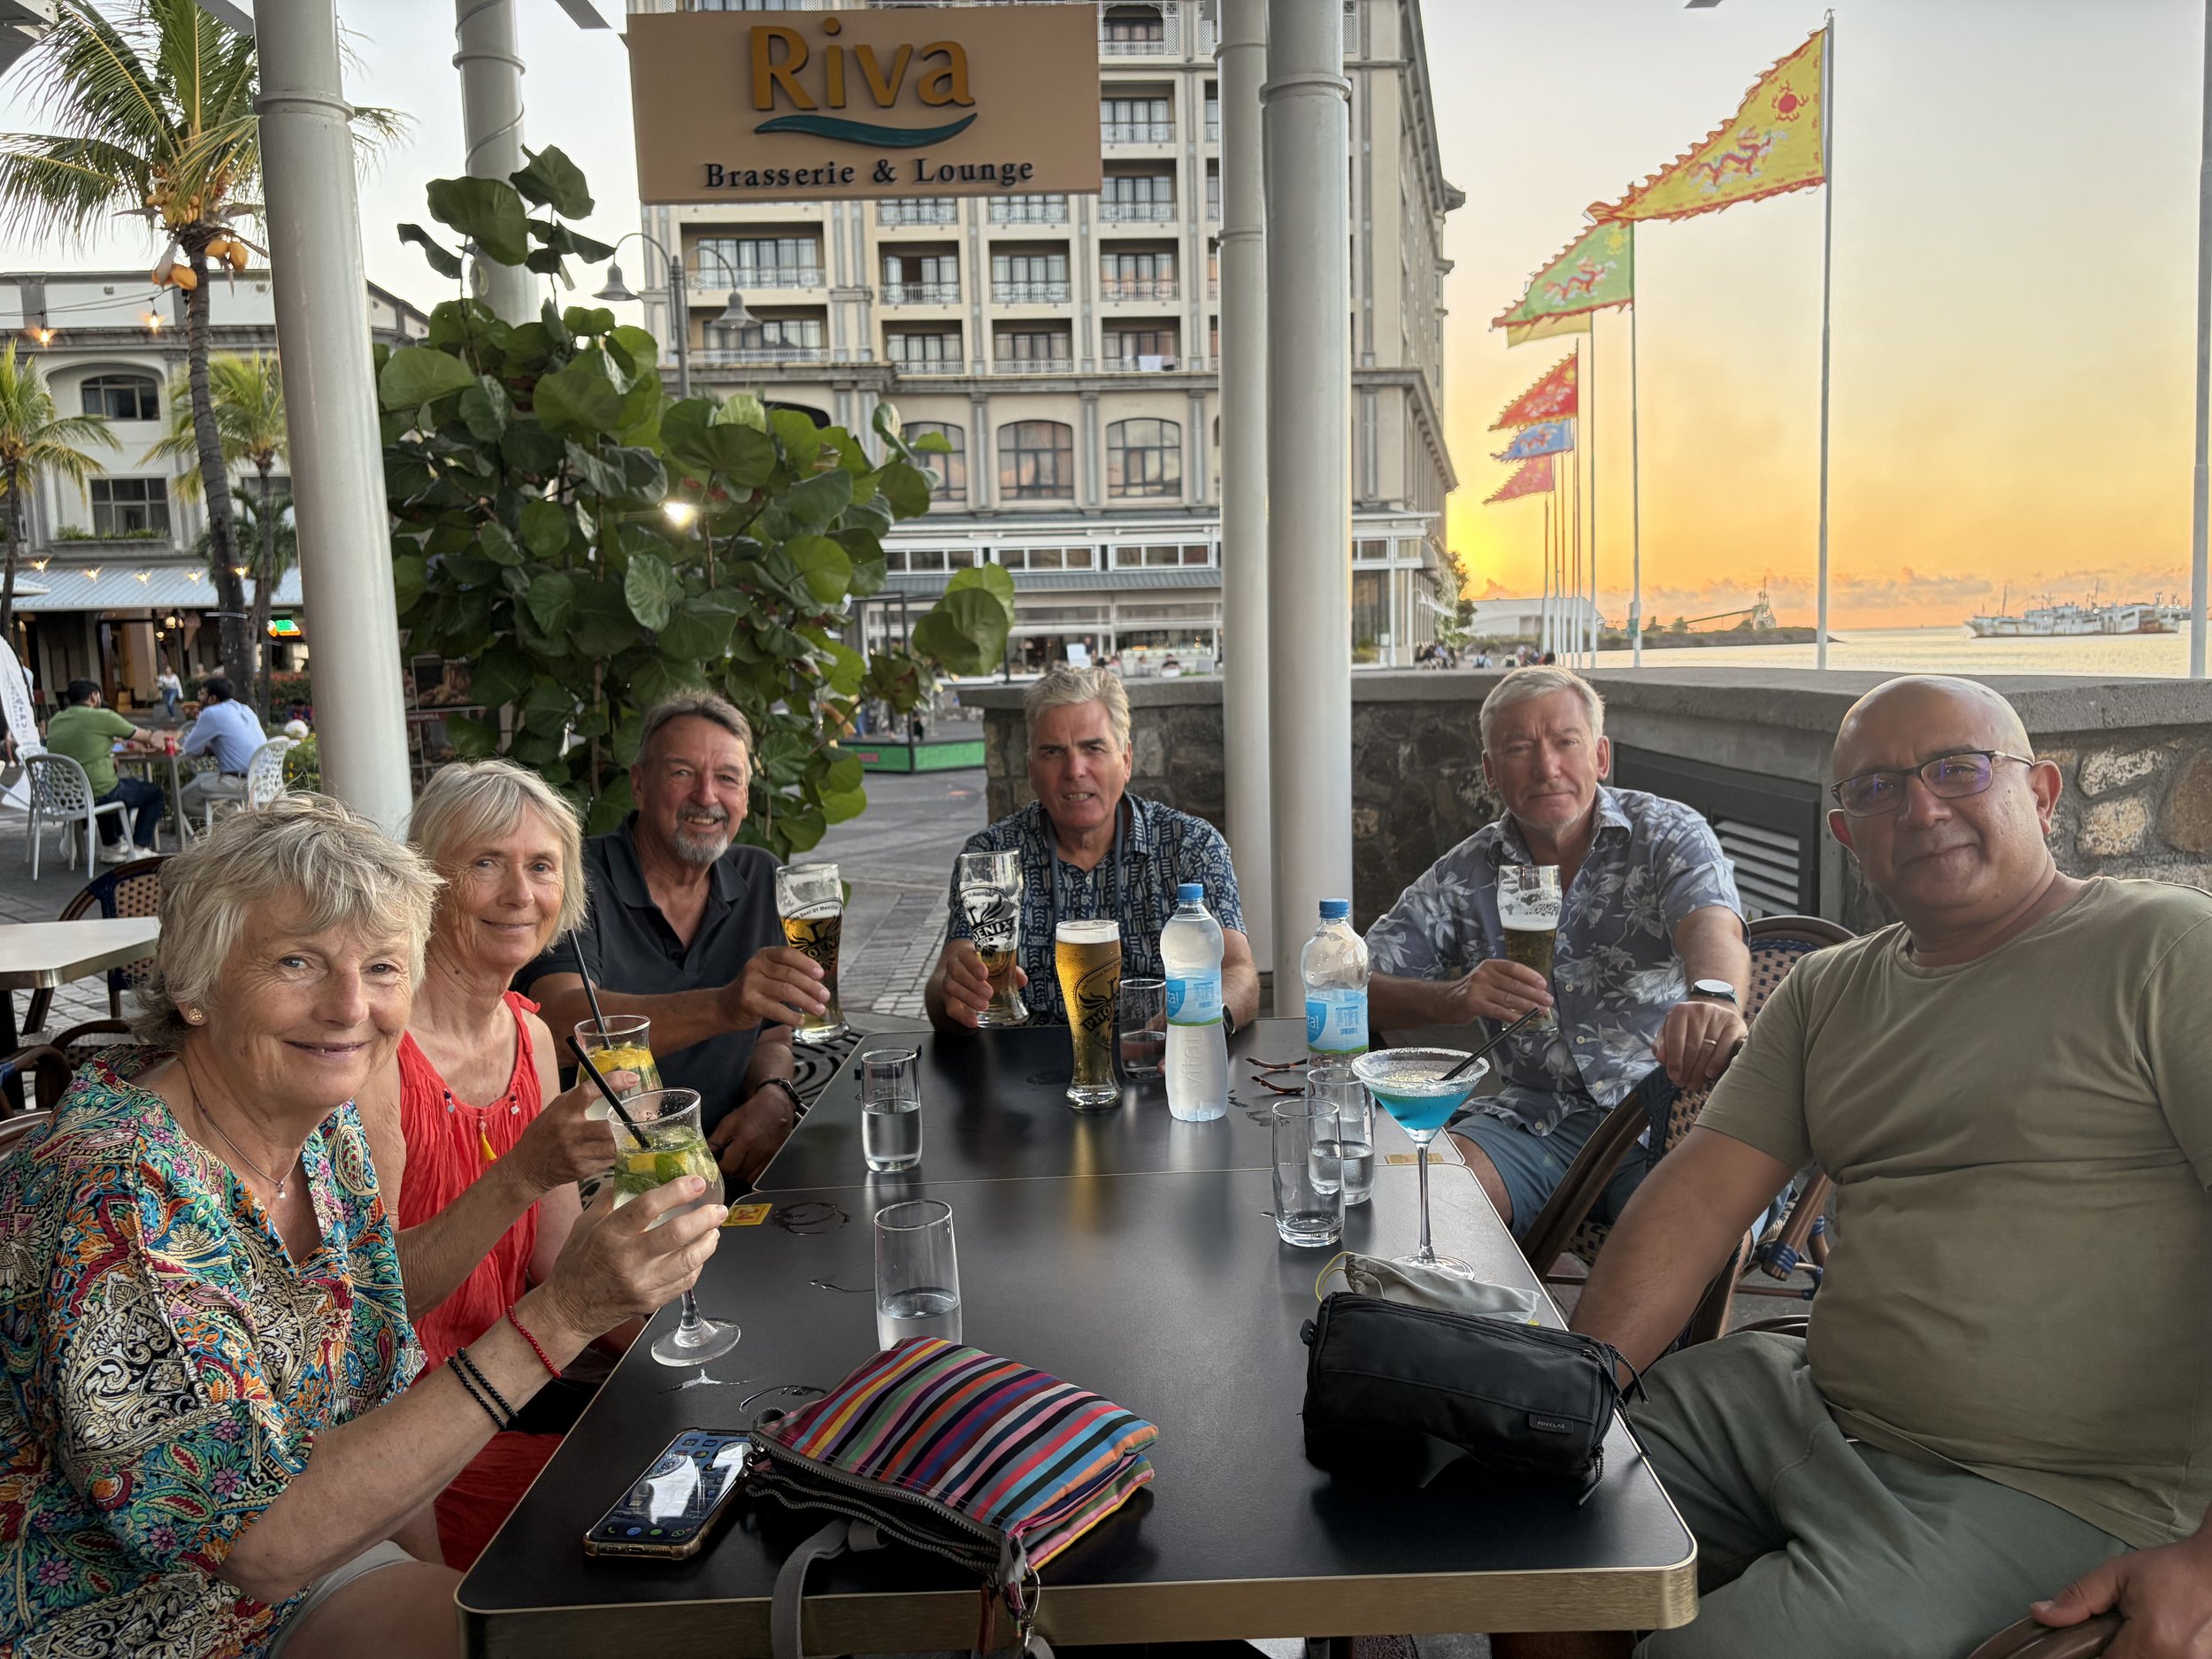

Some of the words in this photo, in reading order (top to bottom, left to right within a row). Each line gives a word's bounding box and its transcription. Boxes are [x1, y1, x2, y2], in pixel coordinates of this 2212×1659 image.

[750, 16, 976, 111] Riva
[704, 161, 855, 188] Brasserie
[872, 158, 899, 184] &
[915, 158, 1034, 188] Lounge
[973, 920, 1012, 942] OENIX
